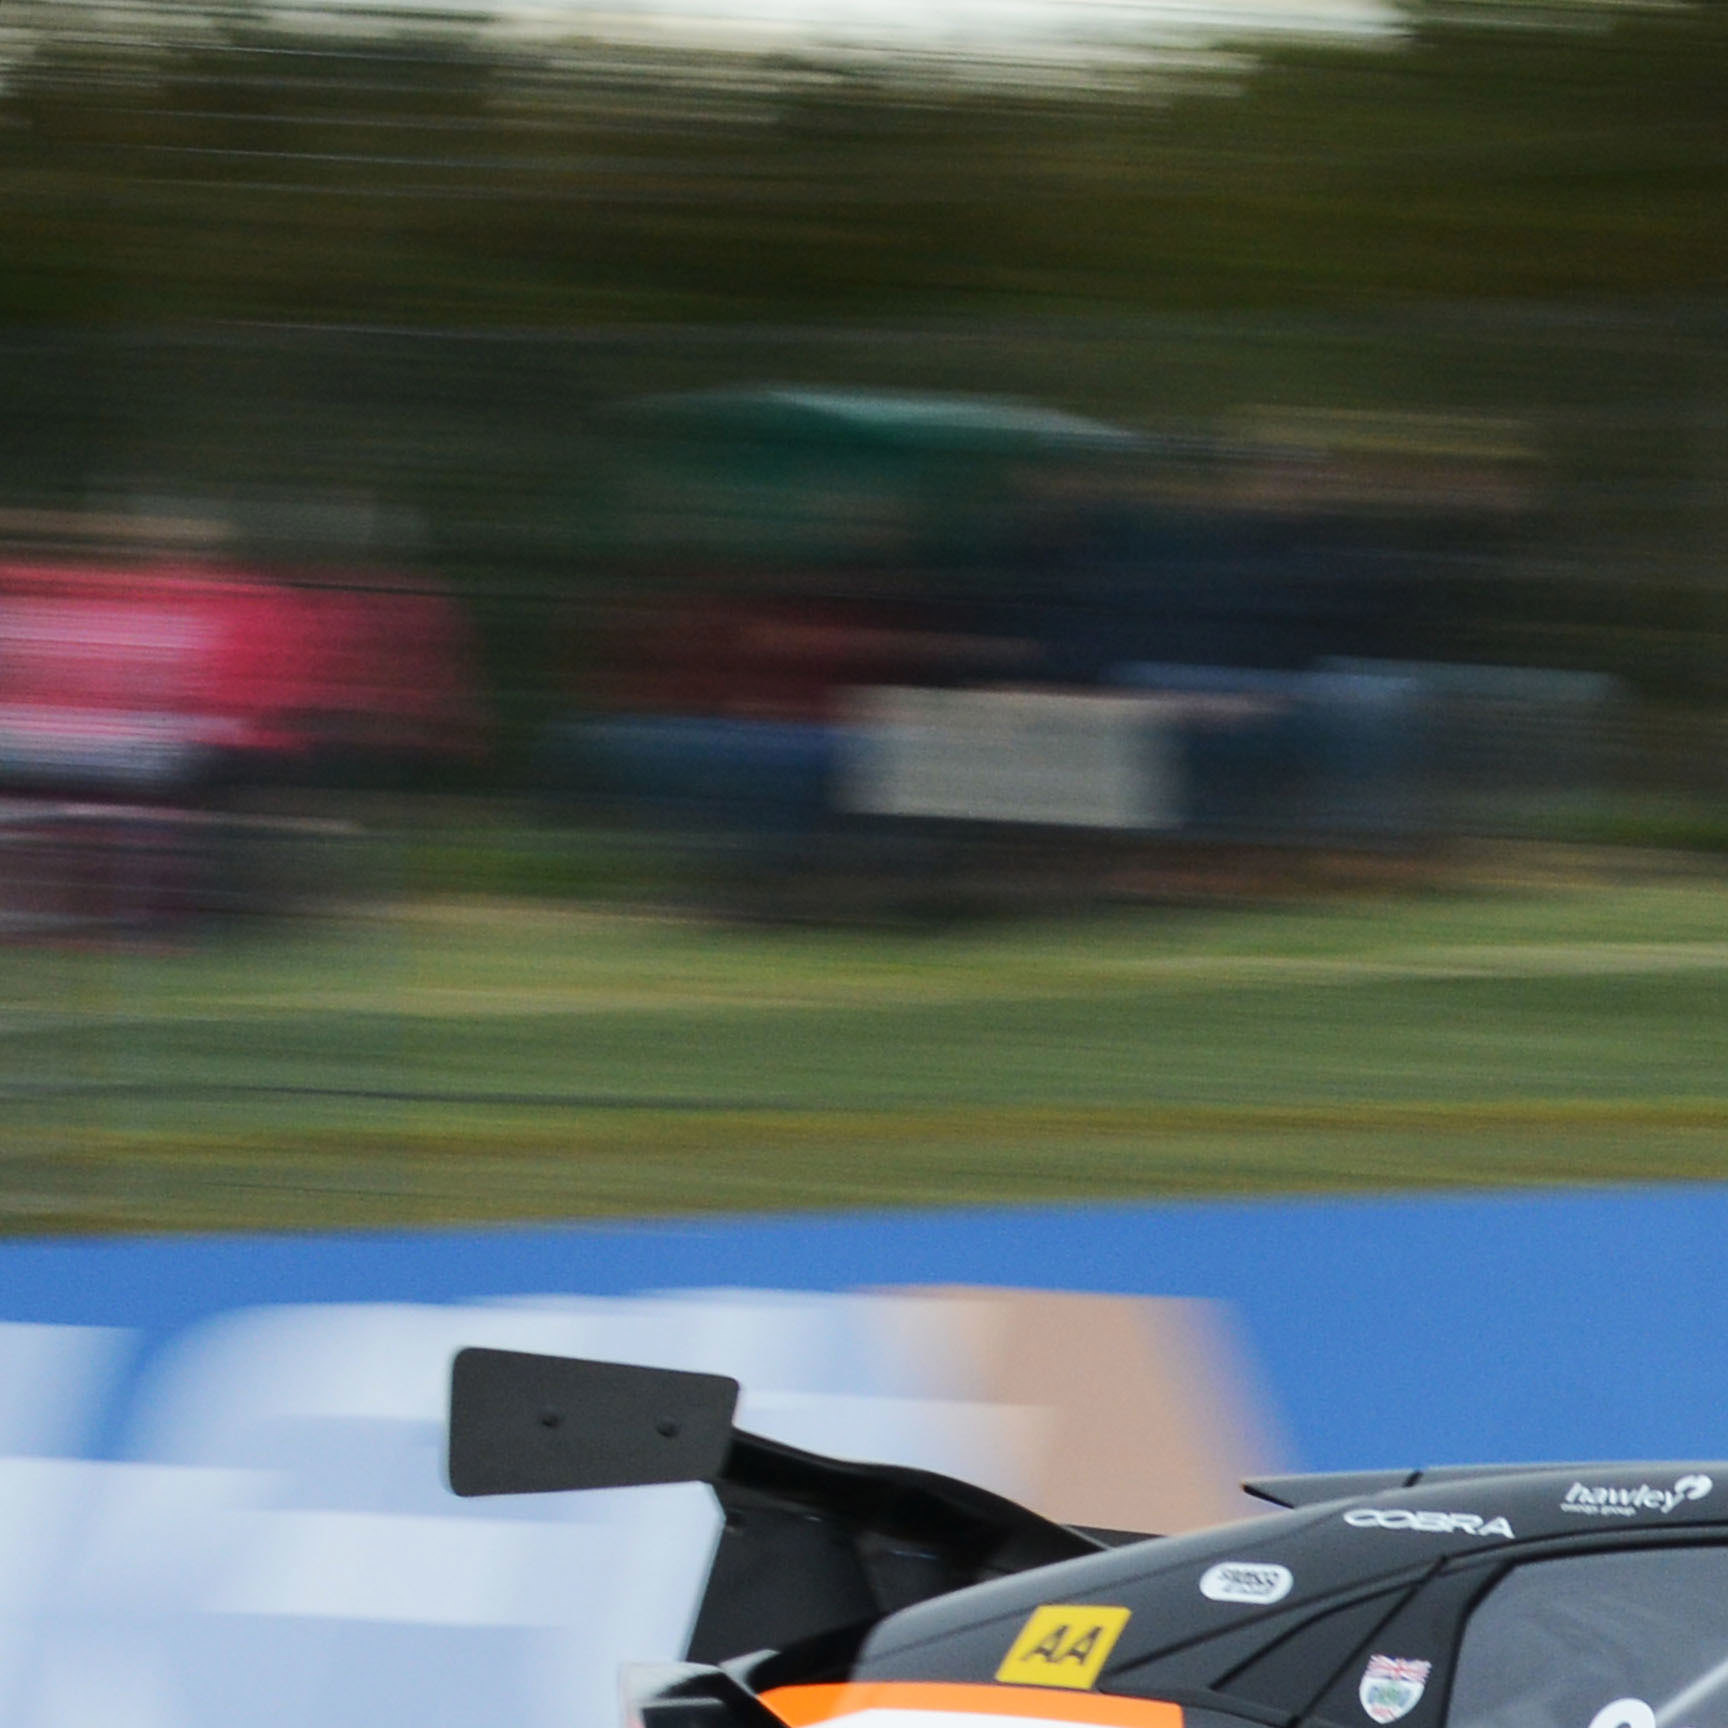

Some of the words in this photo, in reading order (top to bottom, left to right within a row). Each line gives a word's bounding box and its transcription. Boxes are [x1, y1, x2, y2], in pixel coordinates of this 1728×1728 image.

[1564, 1481, 1686, 1515] hawley
[1343, 1508, 1515, 1539] COBRA
[1019, 1625, 1104, 1669] AA
